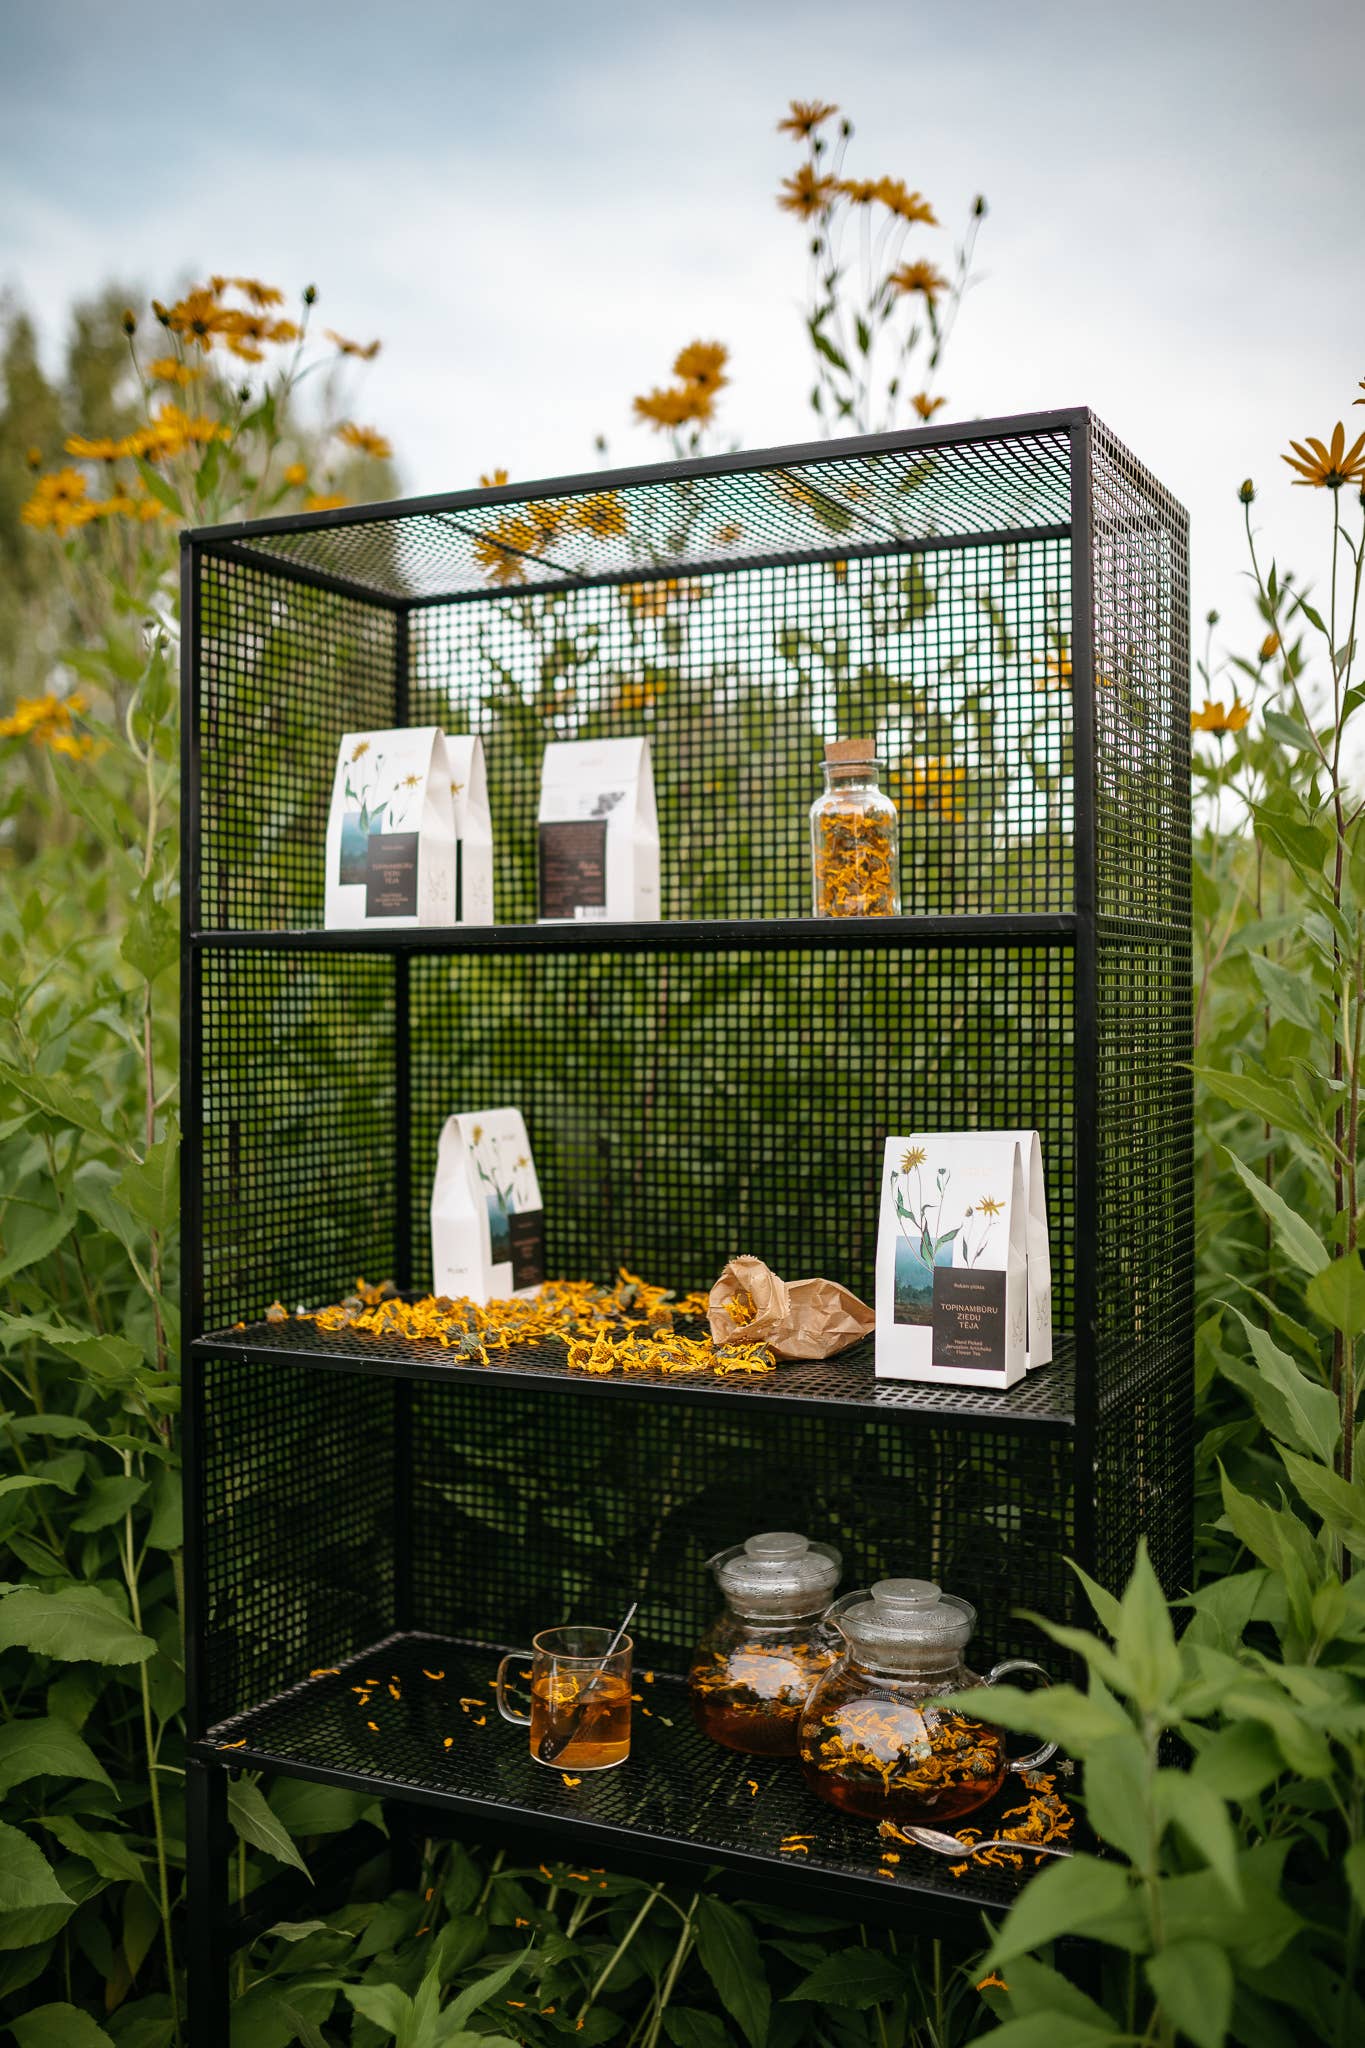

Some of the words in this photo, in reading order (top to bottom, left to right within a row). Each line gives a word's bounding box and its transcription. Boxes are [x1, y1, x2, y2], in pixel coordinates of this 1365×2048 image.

[941, 1303, 998, 1314] TOPINAMBŪRU
[957, 1312, 981, 1321] ZIEDU
[959, 1320, 979, 1330] TĒJA
